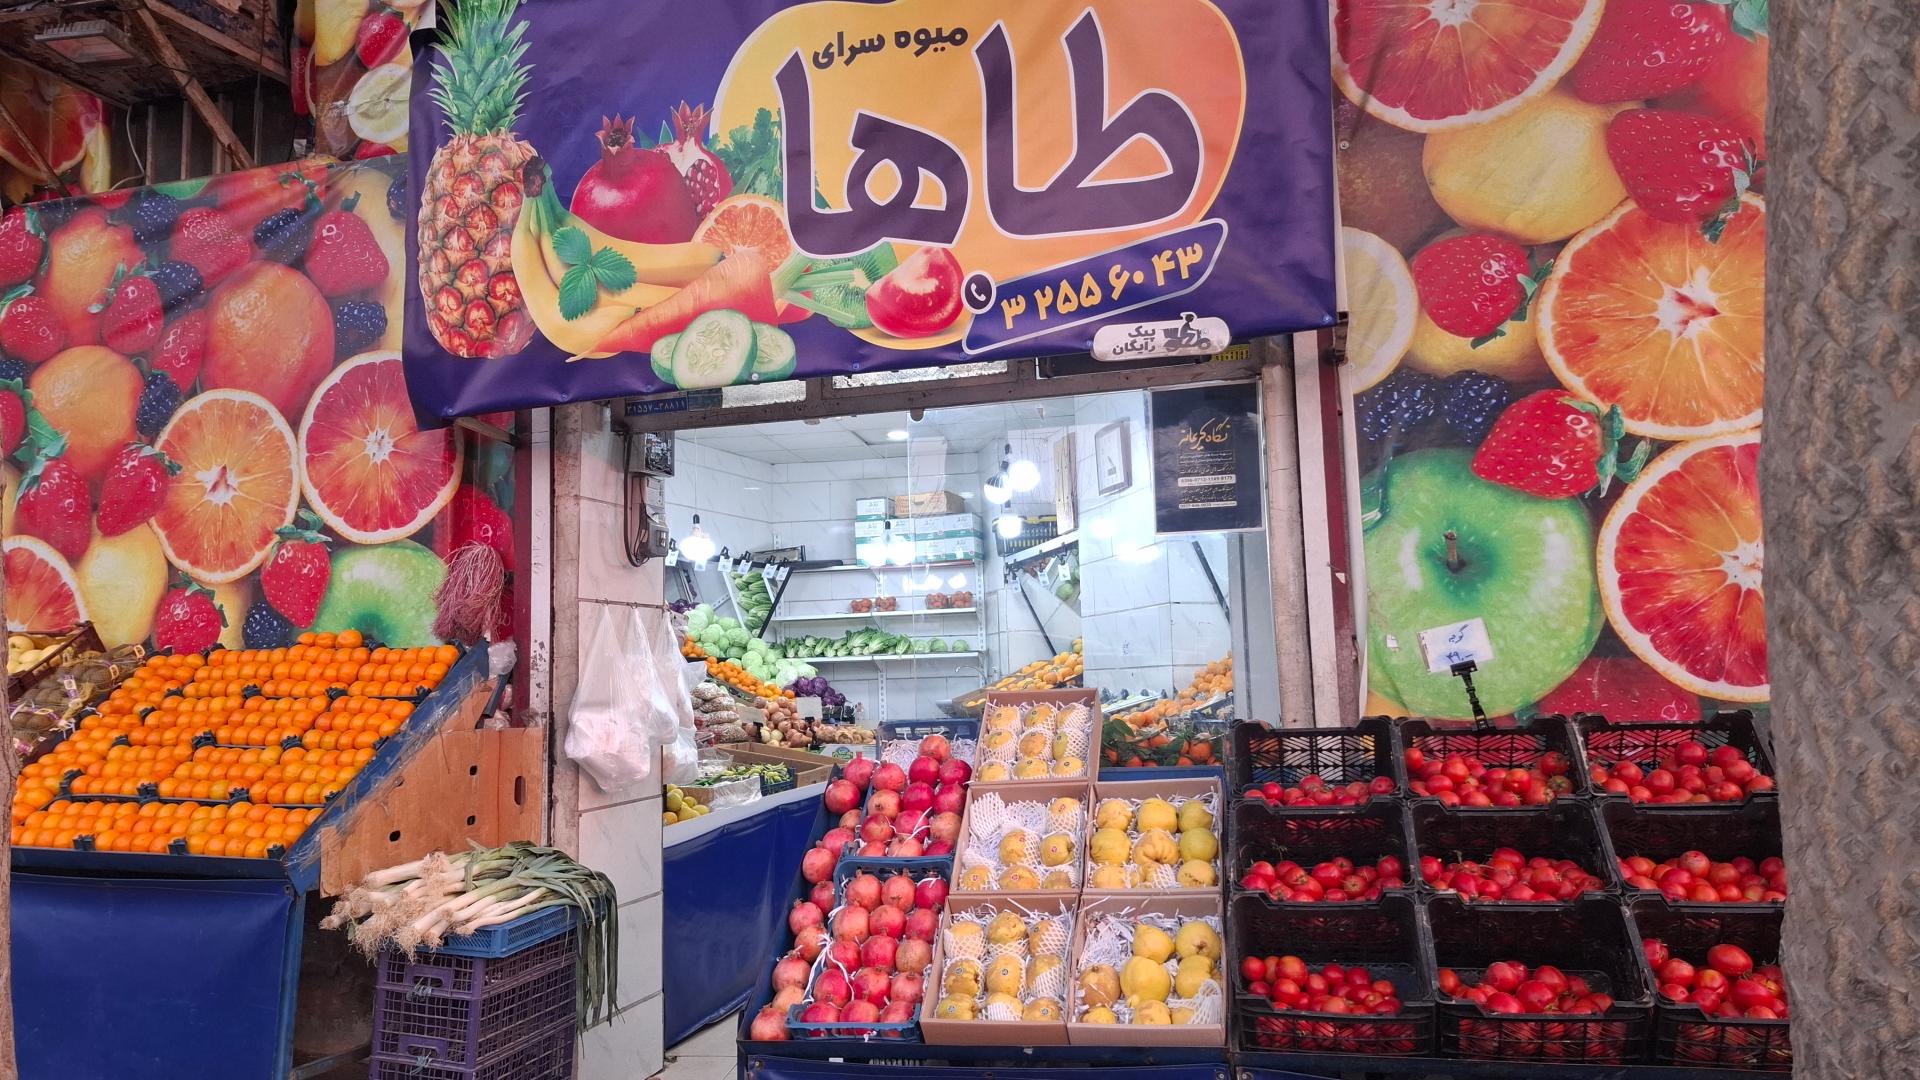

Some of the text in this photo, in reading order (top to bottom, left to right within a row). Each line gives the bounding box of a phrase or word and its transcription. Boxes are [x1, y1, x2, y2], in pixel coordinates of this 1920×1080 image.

[811, 26, 969, 70] میوه سرای
[774, 7, 1203, 258] طاها
[1112, 340, 1156, 355] رایگان
[1127, 325, 1156, 343] پیک
